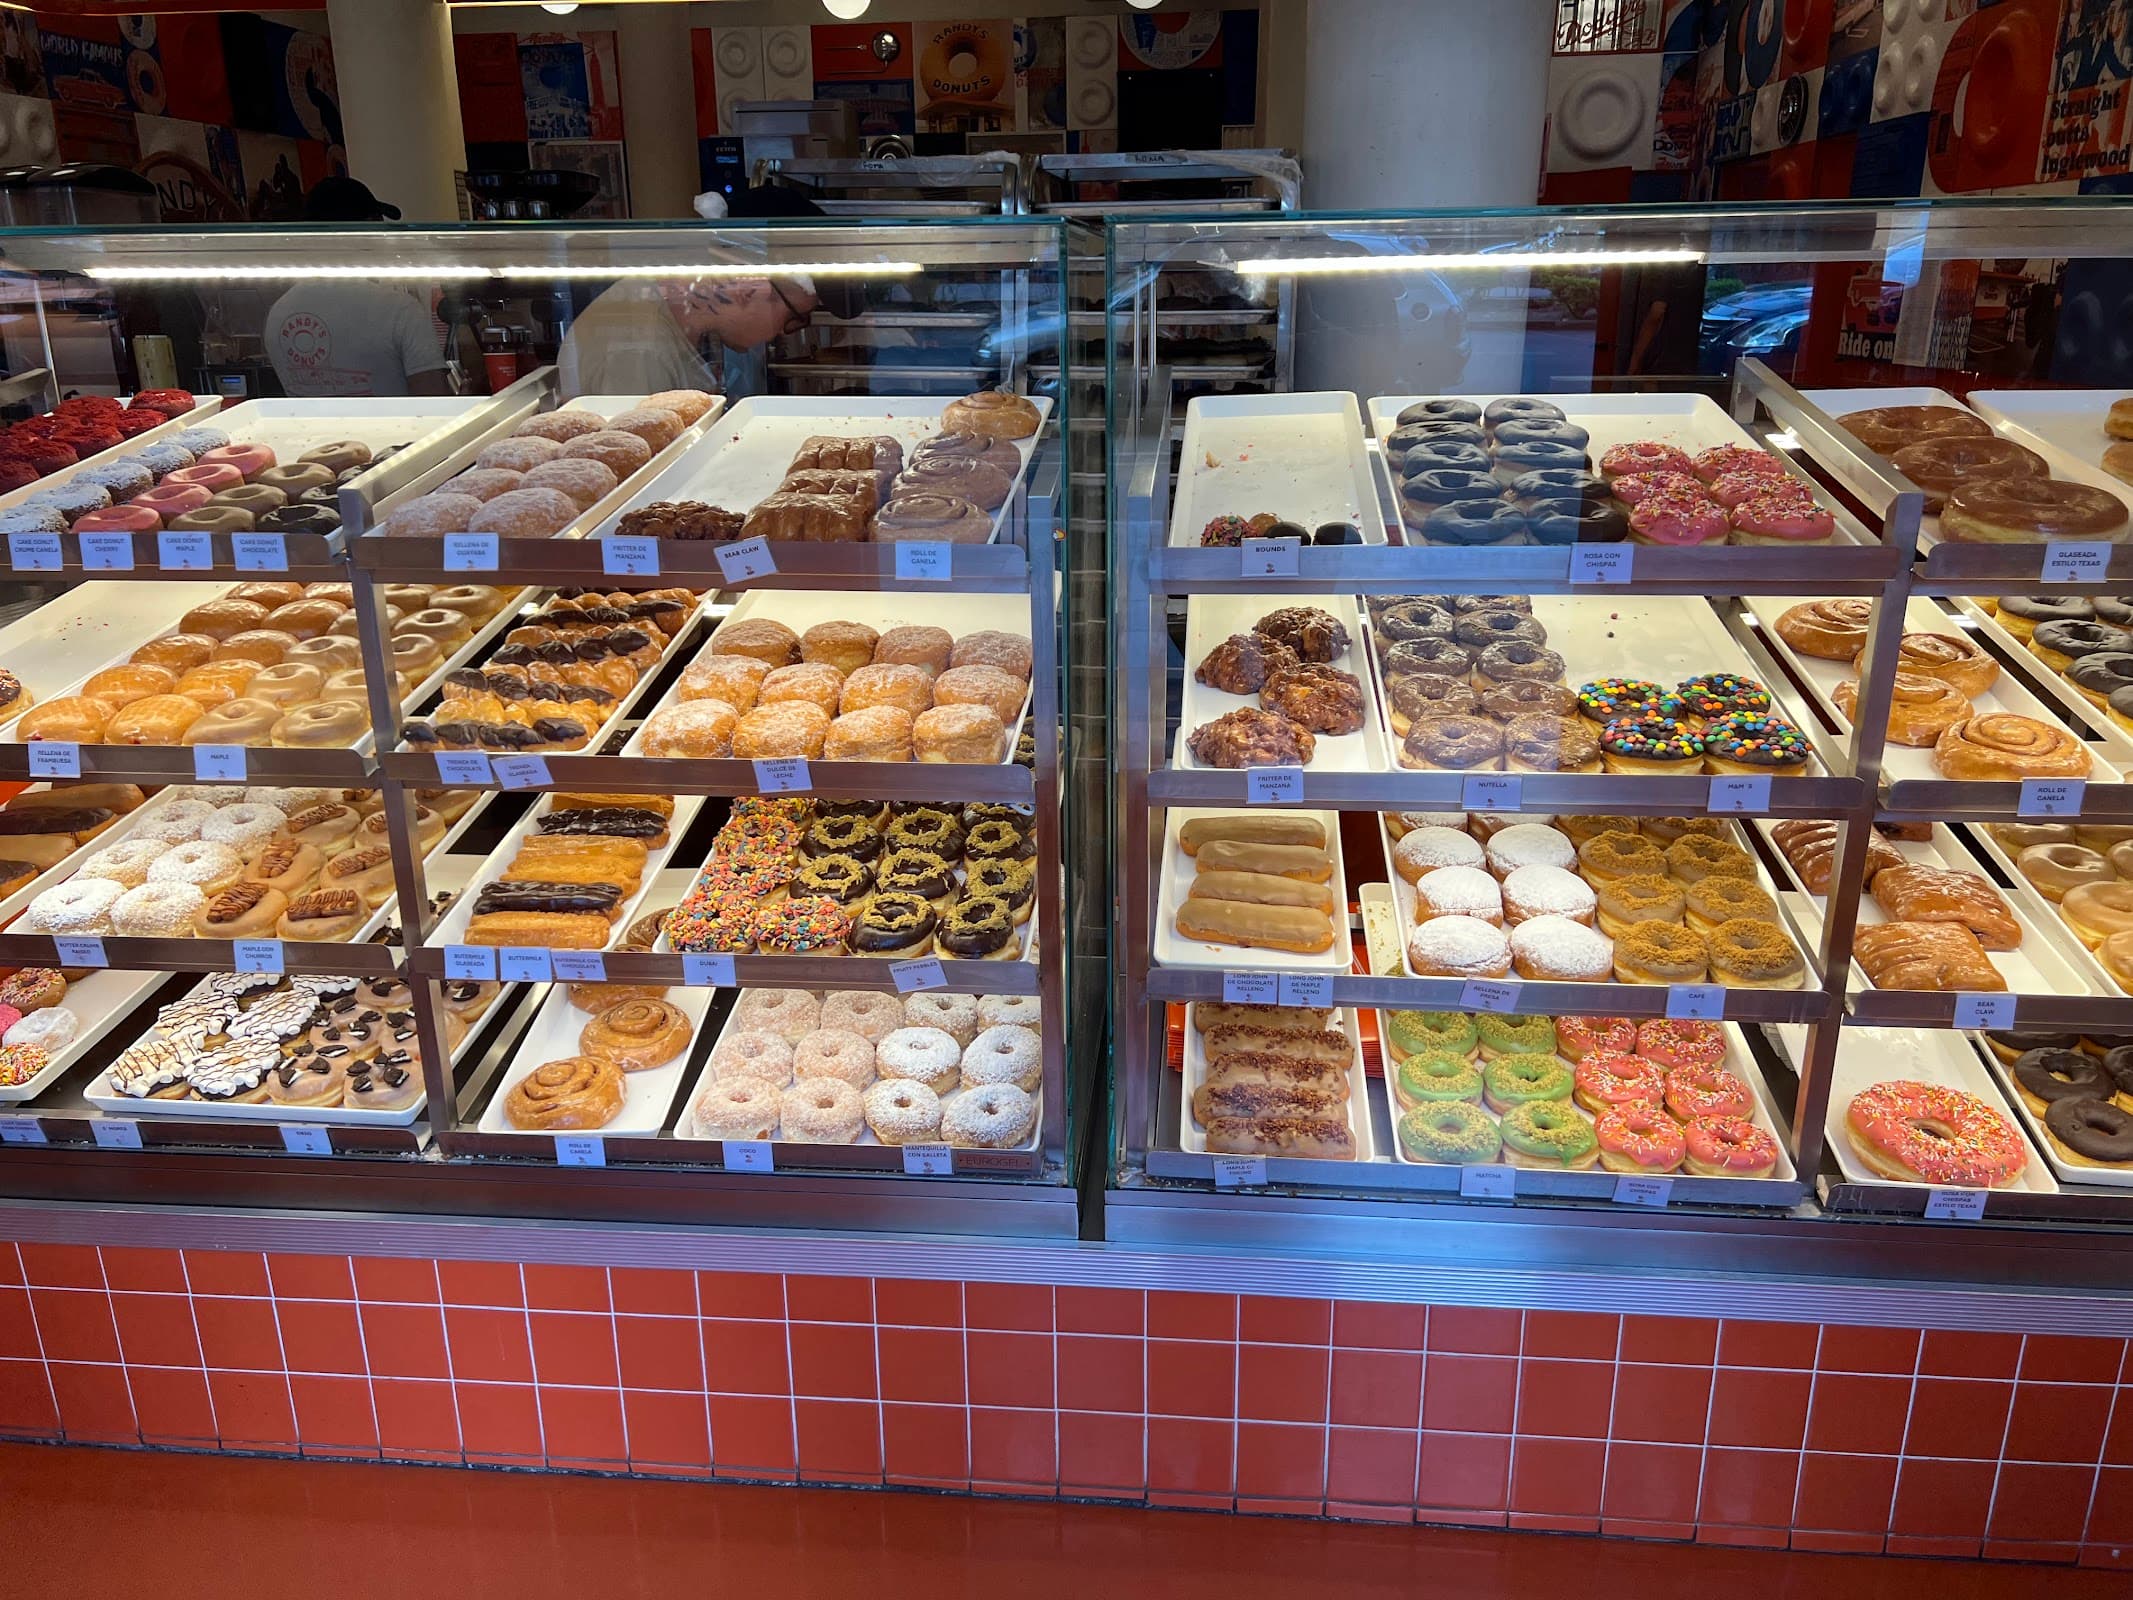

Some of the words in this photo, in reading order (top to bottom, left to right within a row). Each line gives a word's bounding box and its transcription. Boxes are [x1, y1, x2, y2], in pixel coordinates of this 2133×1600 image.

[933, 75, 991, 94] DONUTS
[2051, 88, 2121, 120] Straight
[2046, 125, 2089, 147] outta
[2041, 144, 2130, 177] Inglewood
[282, 317, 327, 338] RANDY'S
[1837, 331, 1870, 357] Ride
[287, 347, 326, 366] DONUTS
[724, 551, 741, 559] BEAR
[741, 546, 759, 555] CLAW
